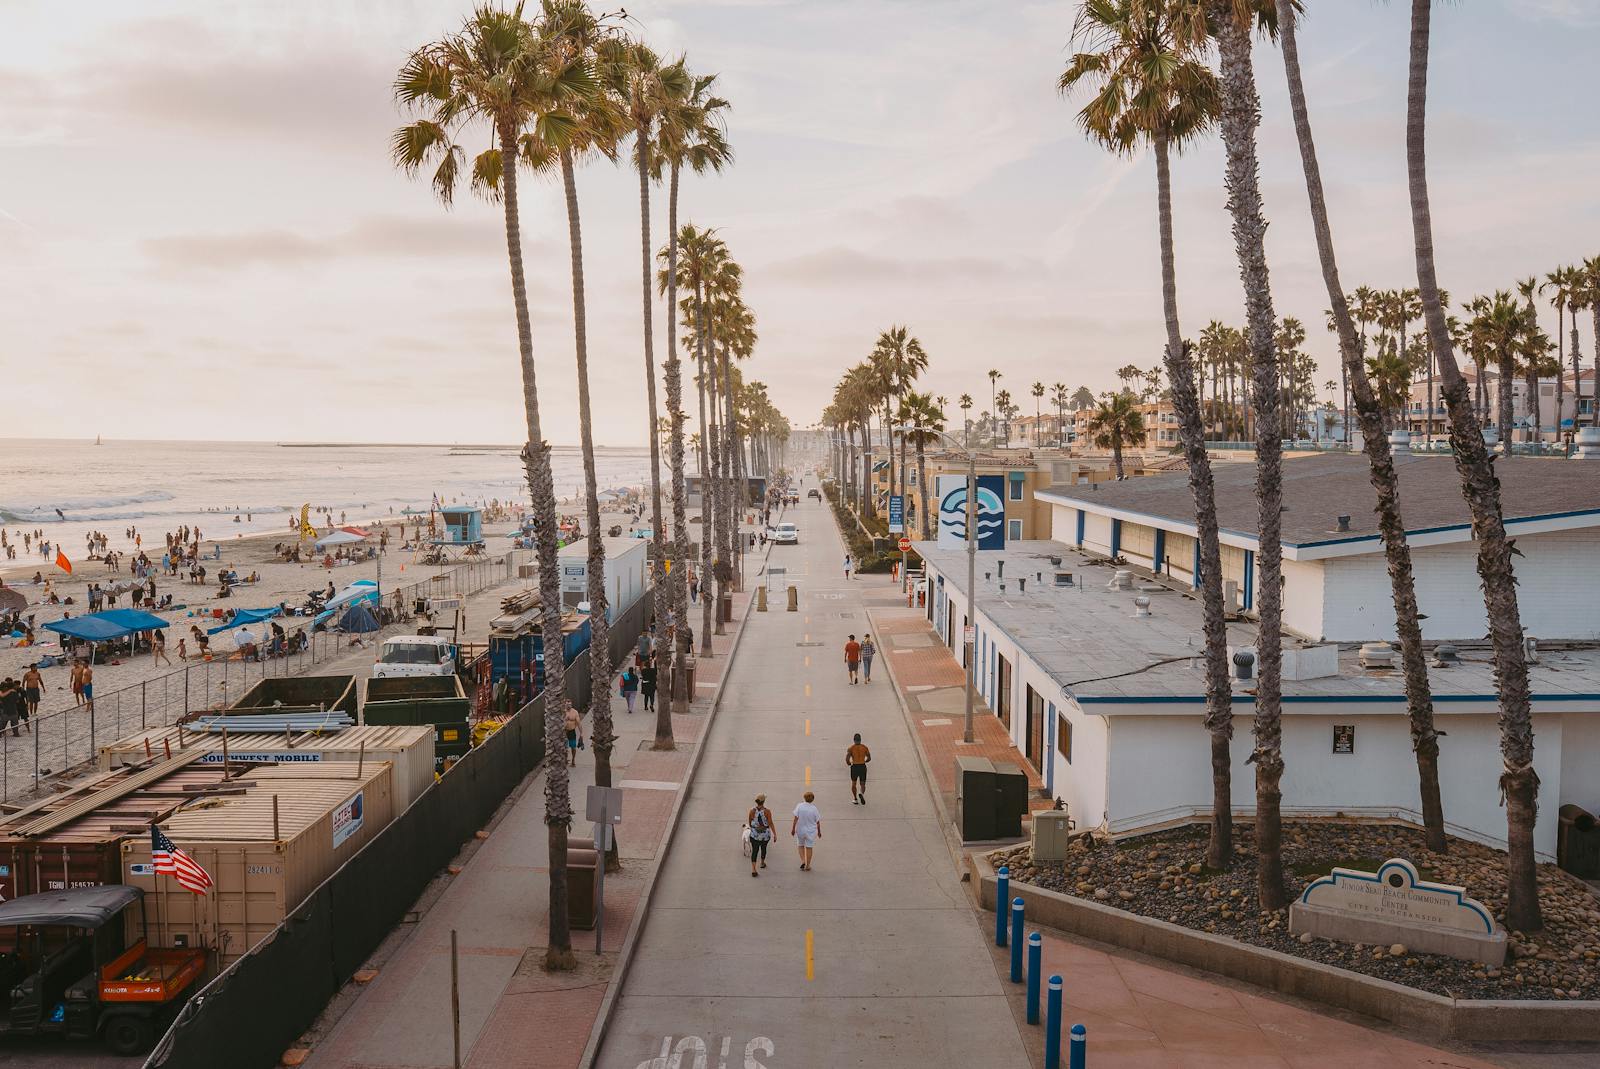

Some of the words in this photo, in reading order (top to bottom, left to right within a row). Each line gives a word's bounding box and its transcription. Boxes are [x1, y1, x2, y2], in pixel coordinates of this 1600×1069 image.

[202, 754, 270, 763] SOUHWEST
[275, 755, 320, 763] MOBILE
[49, 881, 65, 890] TGHU
[1341, 879, 1364, 894] JUNIOR
[1383, 885, 1406, 900] BEACH
[1408, 889, 1451, 907] COMMUNITY
[1381, 898, 1409, 911] CENTER
[1348, 902, 1369, 911] CITY
[1390, 909, 1444, 923] OCEANSIDE
